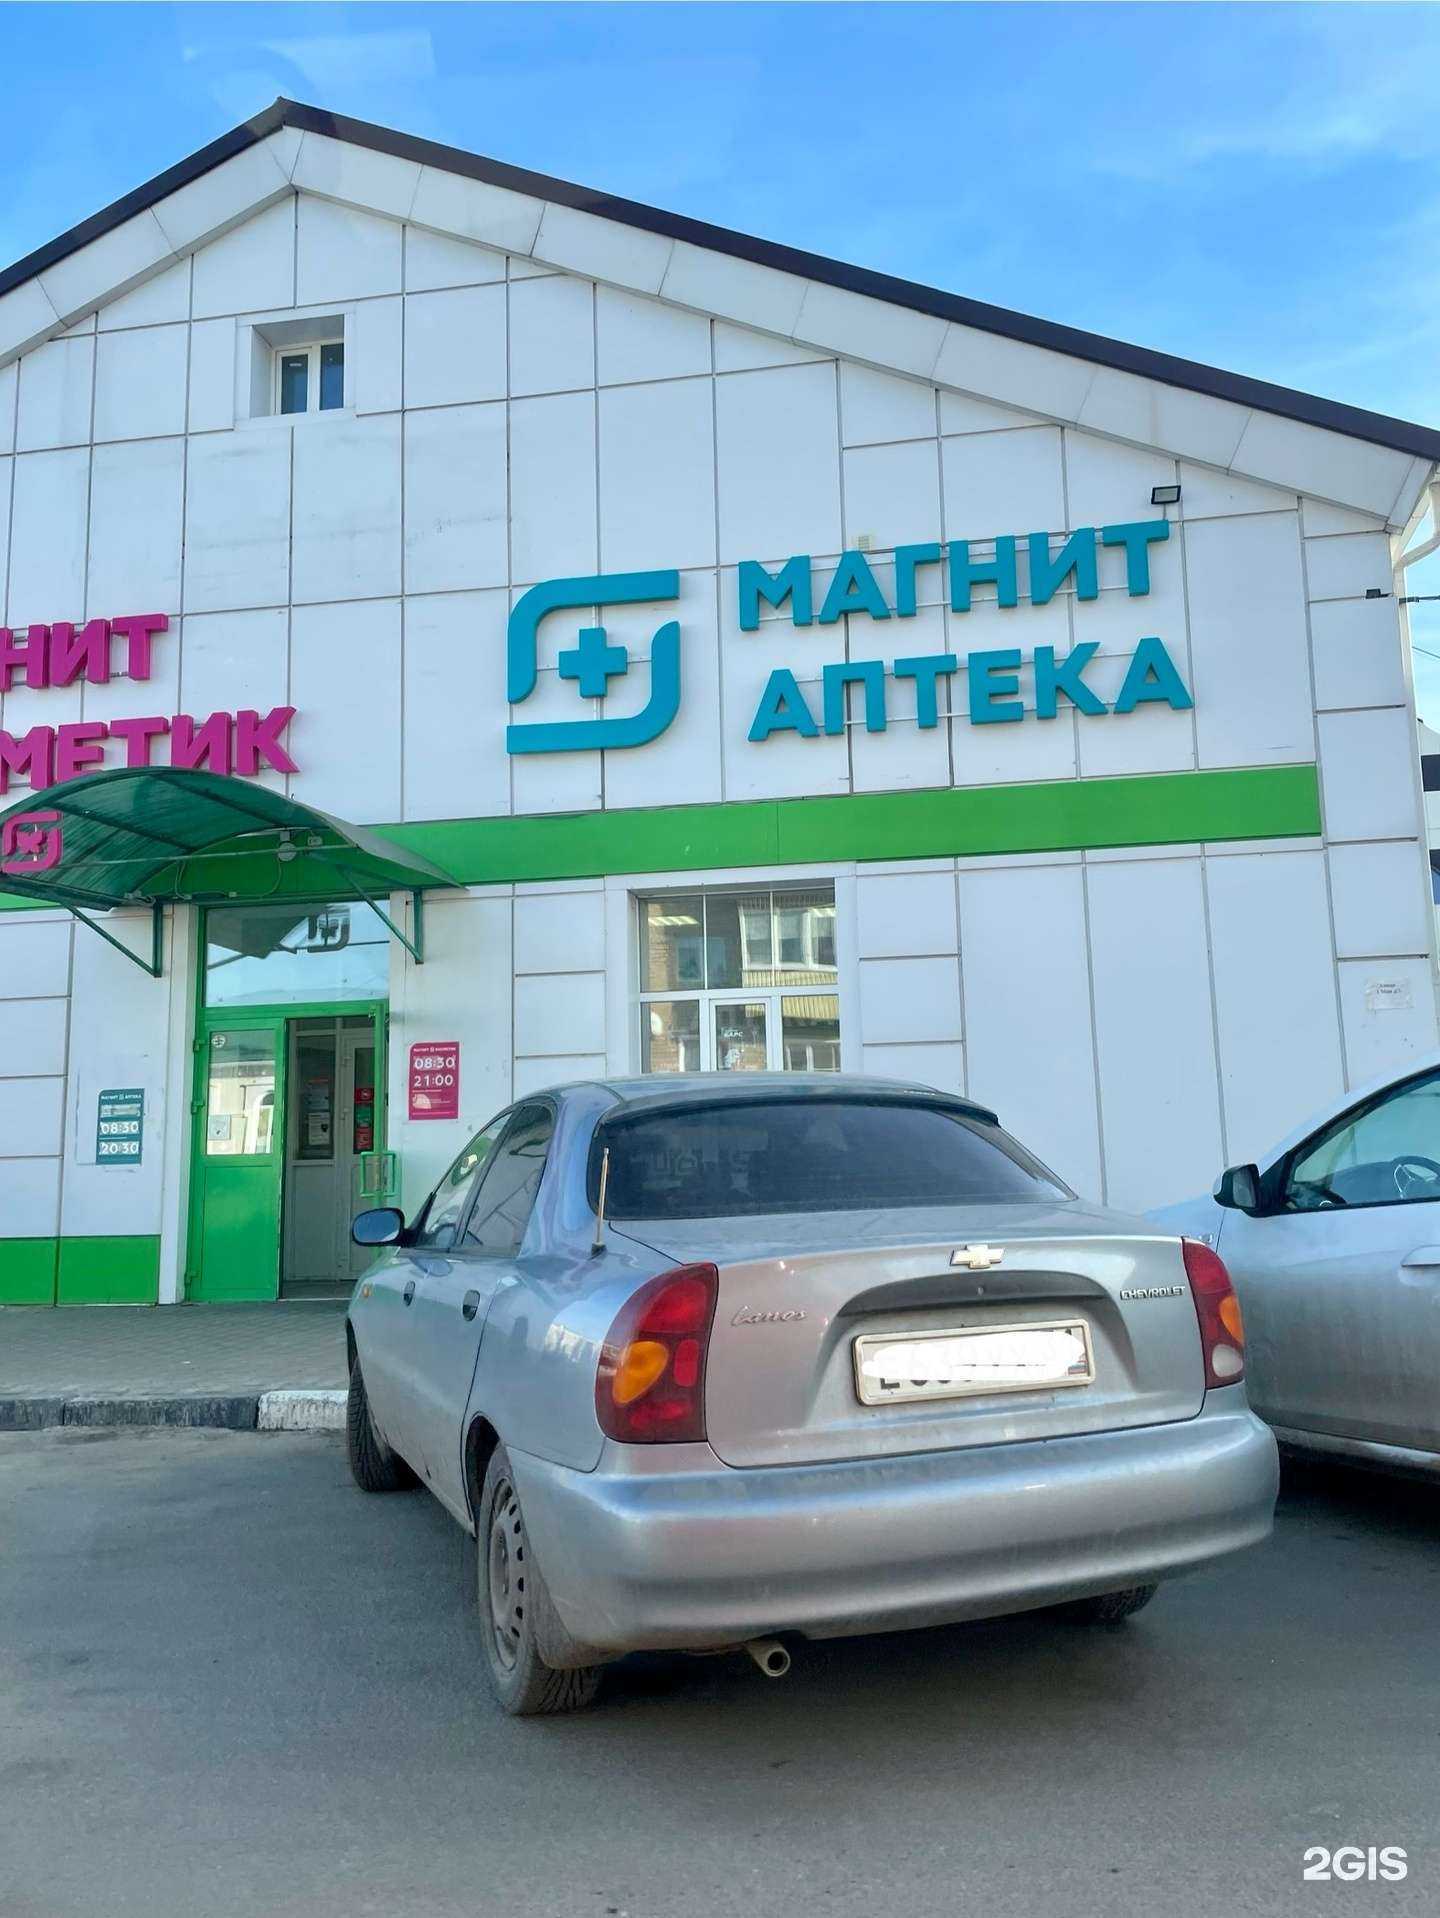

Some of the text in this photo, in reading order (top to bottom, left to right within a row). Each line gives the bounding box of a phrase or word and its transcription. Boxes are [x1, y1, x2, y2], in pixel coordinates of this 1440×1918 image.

[738, 519, 1170, 632] МАГНИТ
[0, 613, 168, 692] НИТ
[747, 637, 1194, 742] АПТЕКА
[0, 706, 300, 795] МЕТИК
[414, 1056, 455, 1070] 08:30
[413, 1074, 454, 1088] 21:00
[100, 1121, 139, 1135] 08:30
[100, 1141, 139, 1155] 20:30
[1120, 1285, 1186, 1301] CHEVROLET
